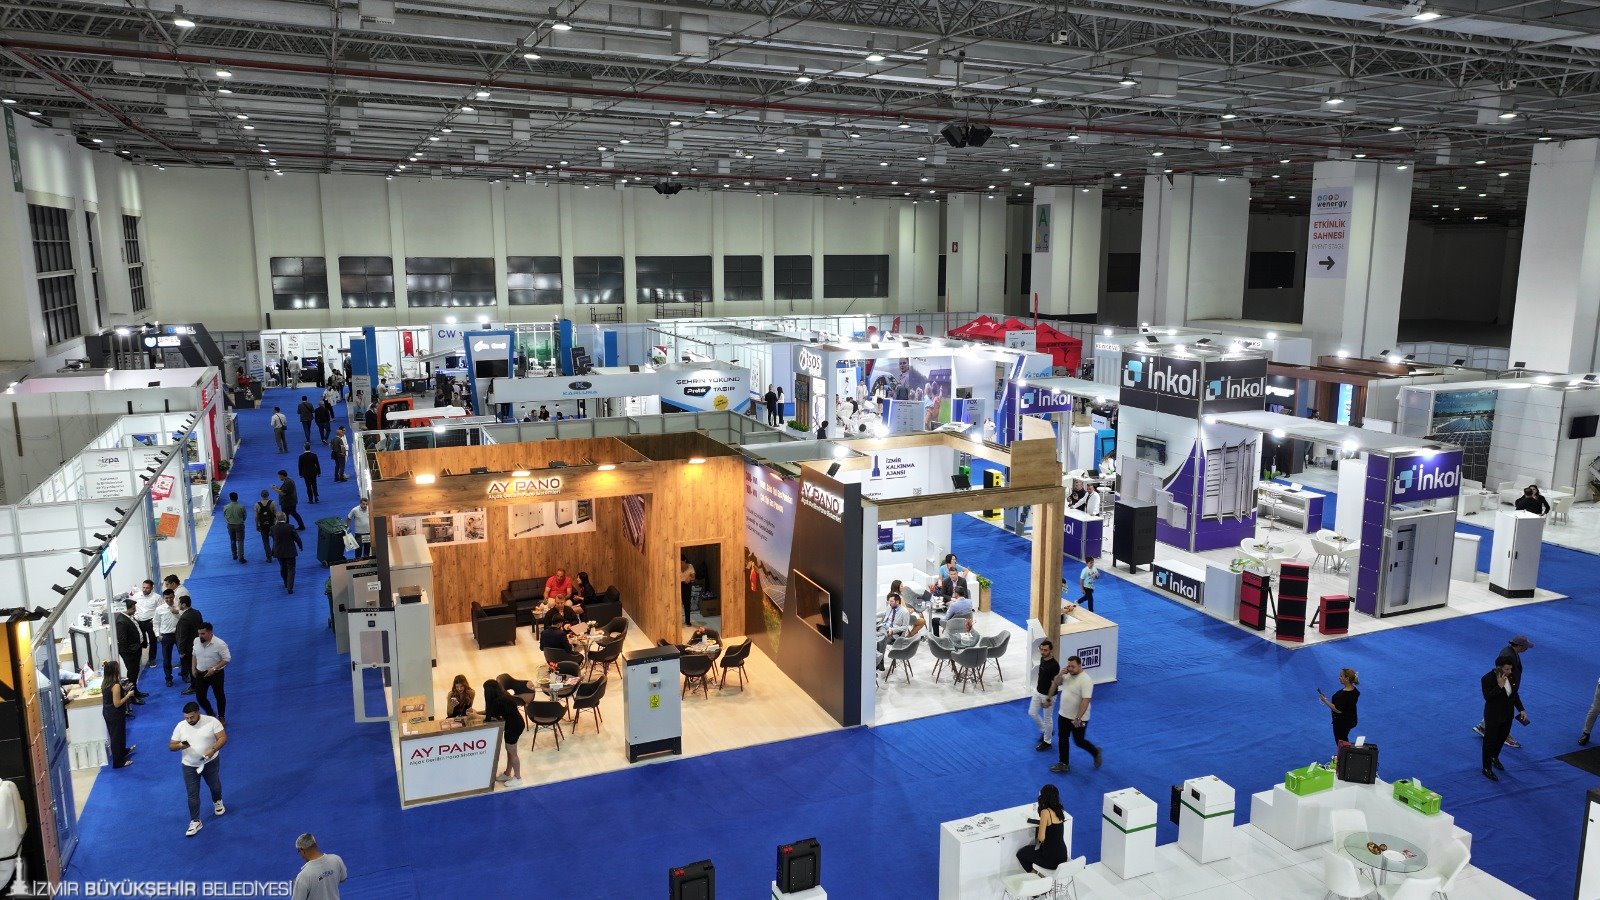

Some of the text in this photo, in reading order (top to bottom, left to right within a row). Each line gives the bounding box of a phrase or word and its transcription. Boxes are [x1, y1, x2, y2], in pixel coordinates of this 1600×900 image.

[1317, 200, 1348, 208] wenergy
[1313, 219, 1346, 229] ETKİNLİK
[1312, 230, 1345, 240] SAHNESİ
[437, 329, 456, 338] CW
[488, 478, 560, 494] AY PANO
[813, 488, 840, 514] PANO
[411, 739, 487, 760] AY PANO
